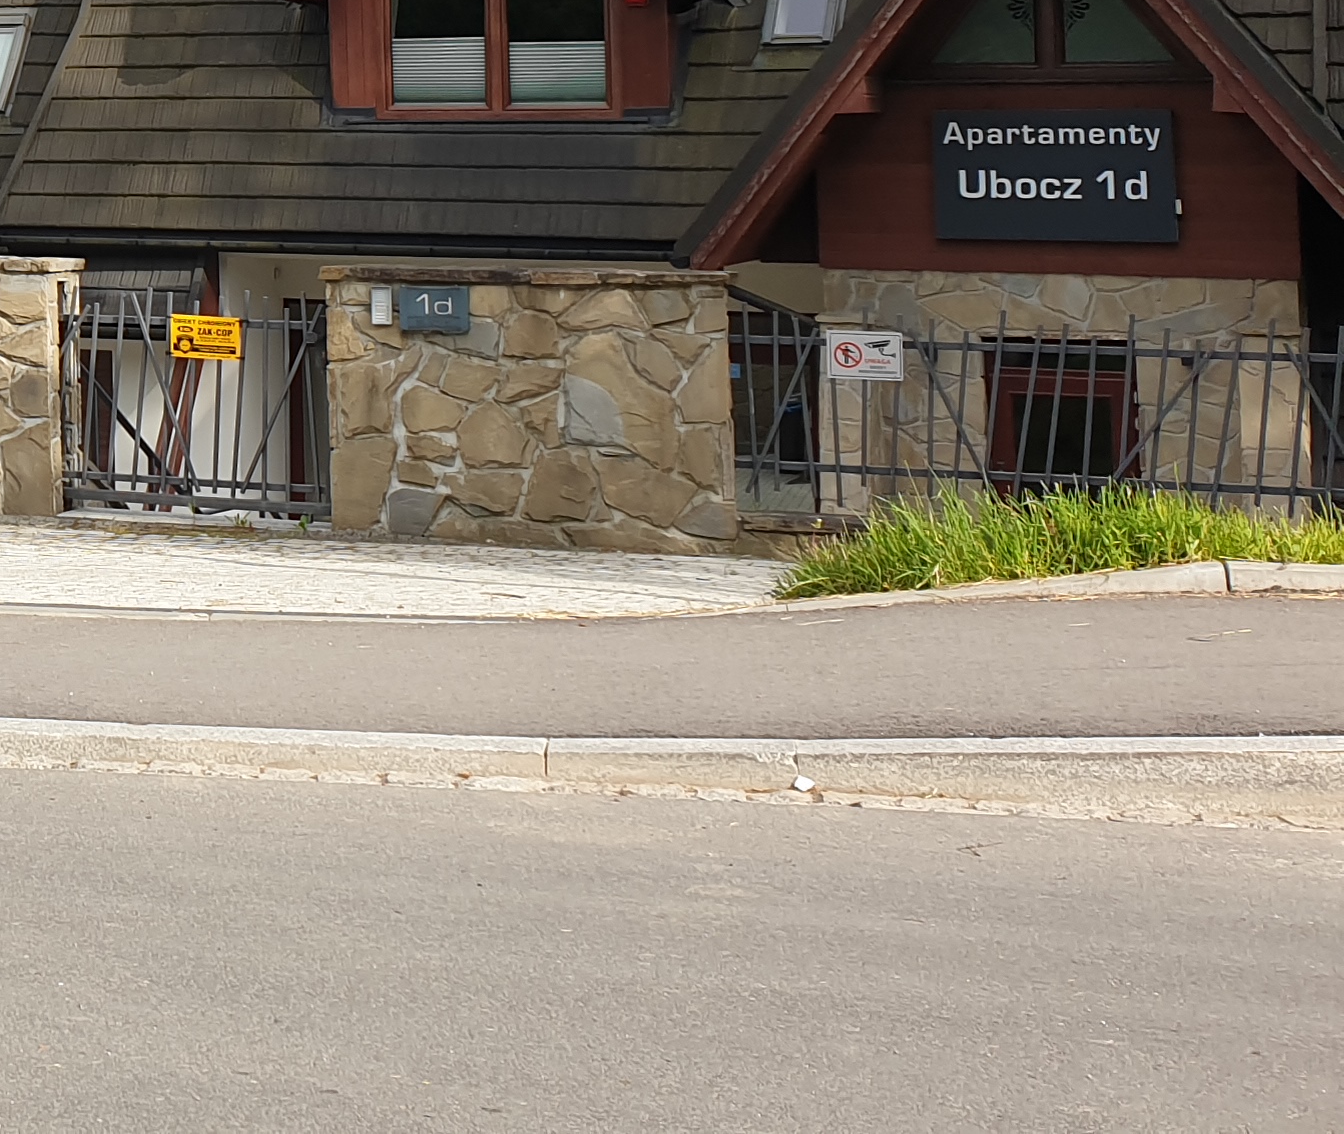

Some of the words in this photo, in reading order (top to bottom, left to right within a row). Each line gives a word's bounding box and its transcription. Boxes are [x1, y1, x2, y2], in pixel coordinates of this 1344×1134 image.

[942, 121, 1161, 151] Apartamenty
[957, 169, 1083, 200] Ubocz
[1095, 170, 1149, 200] 1d
[415, 293, 453, 315] 1d
